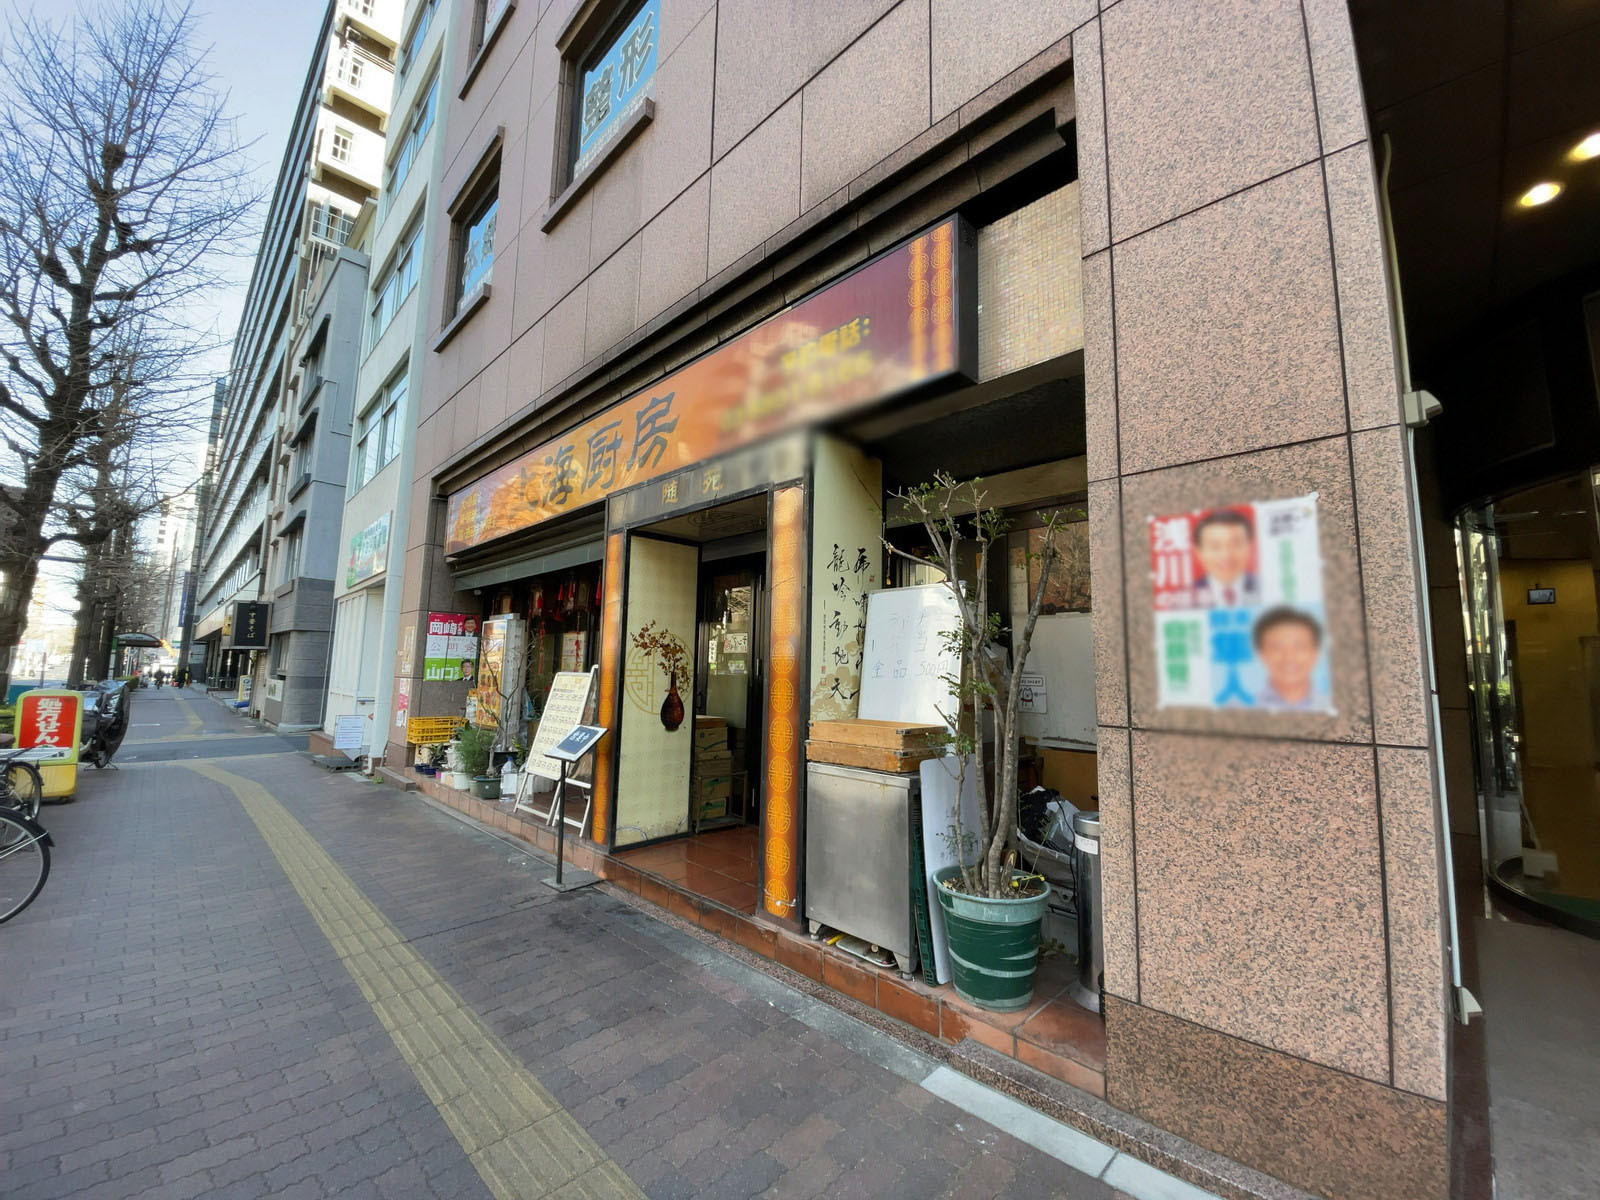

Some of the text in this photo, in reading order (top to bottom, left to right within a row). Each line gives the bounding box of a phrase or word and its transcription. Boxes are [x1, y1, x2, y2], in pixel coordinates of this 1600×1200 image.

[582, 11, 654, 146] 整形
[426, 666, 454, 679] 山口
[35, 698, 62, 744] 処方せん
